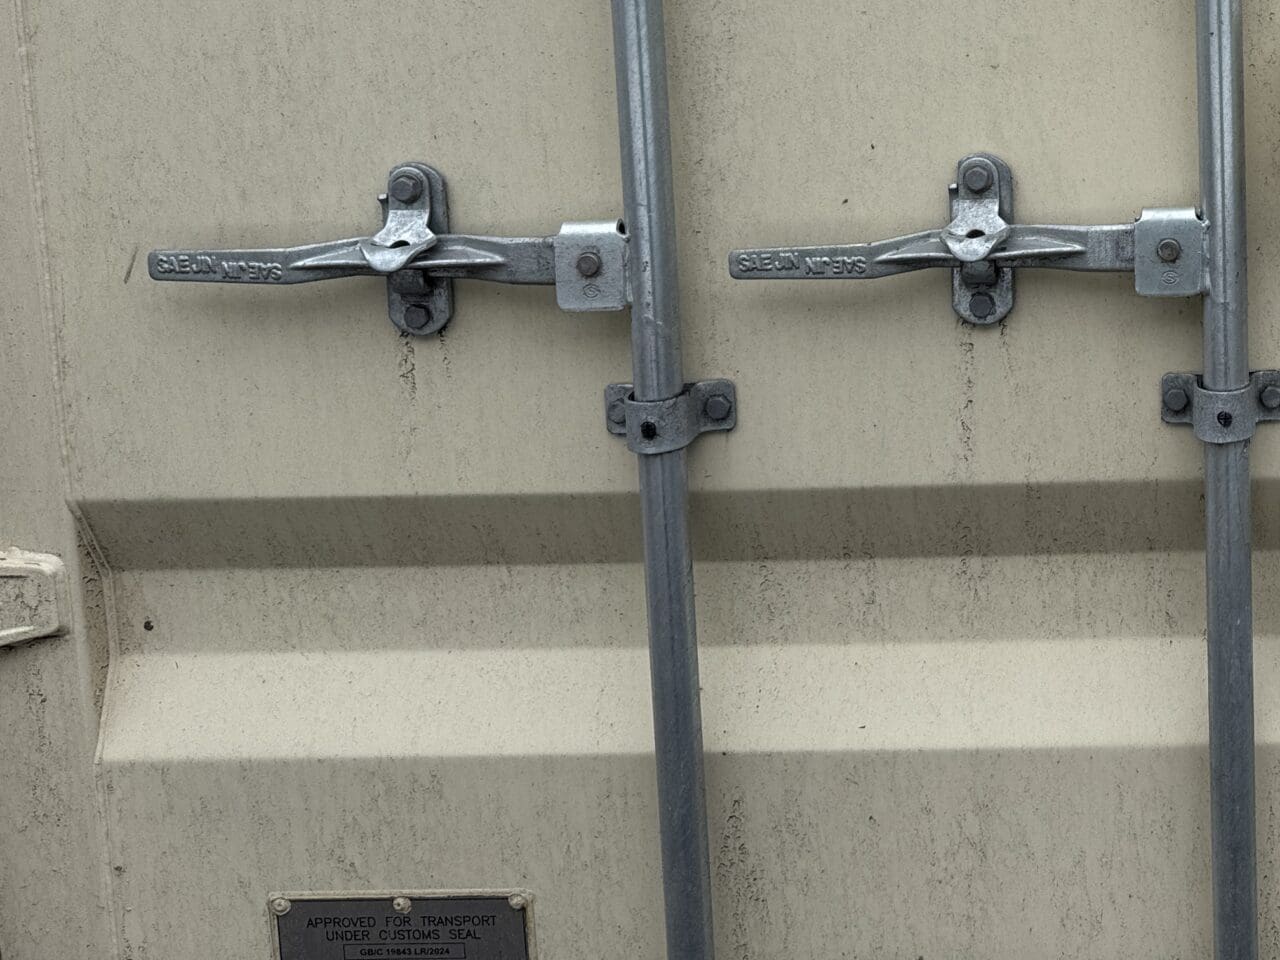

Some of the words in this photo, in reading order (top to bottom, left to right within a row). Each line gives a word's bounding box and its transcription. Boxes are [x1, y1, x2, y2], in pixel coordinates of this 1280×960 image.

[306, 917, 376, 929] APPROVED
[385, 916, 412, 927] FOR
[420, 915, 497, 927] TRANSPORT
[325, 930, 370, 941] UNDER
[378, 929, 441, 941] CUSTOMS
[449, 928, 482, 940] SEAL
